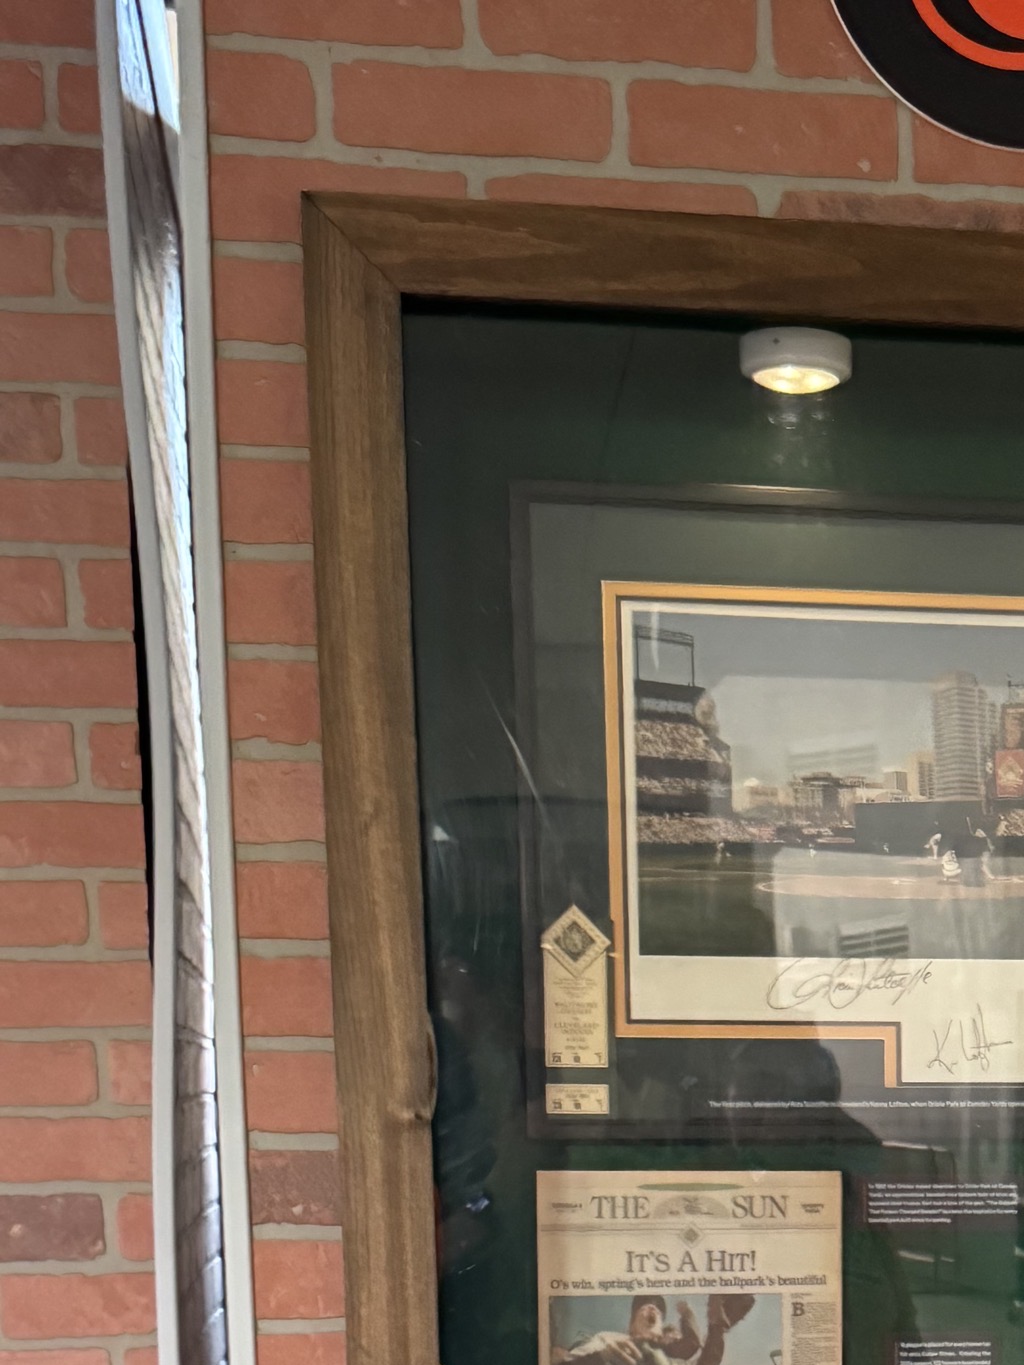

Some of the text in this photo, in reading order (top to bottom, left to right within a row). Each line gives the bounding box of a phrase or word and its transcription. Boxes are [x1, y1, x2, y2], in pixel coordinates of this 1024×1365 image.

[590, 1195, 651, 1219] THE
[731, 1194, 788, 1219] SUN
[677, 1250, 699, 1273] A
[646, 1277, 672, 1288] here
[674, 1277, 696, 1287] and
[699, 1276, 717, 1287] the
[719, 1275, 775, 1289] ballpark's
[778, 1274, 827, 1286] beautiful
